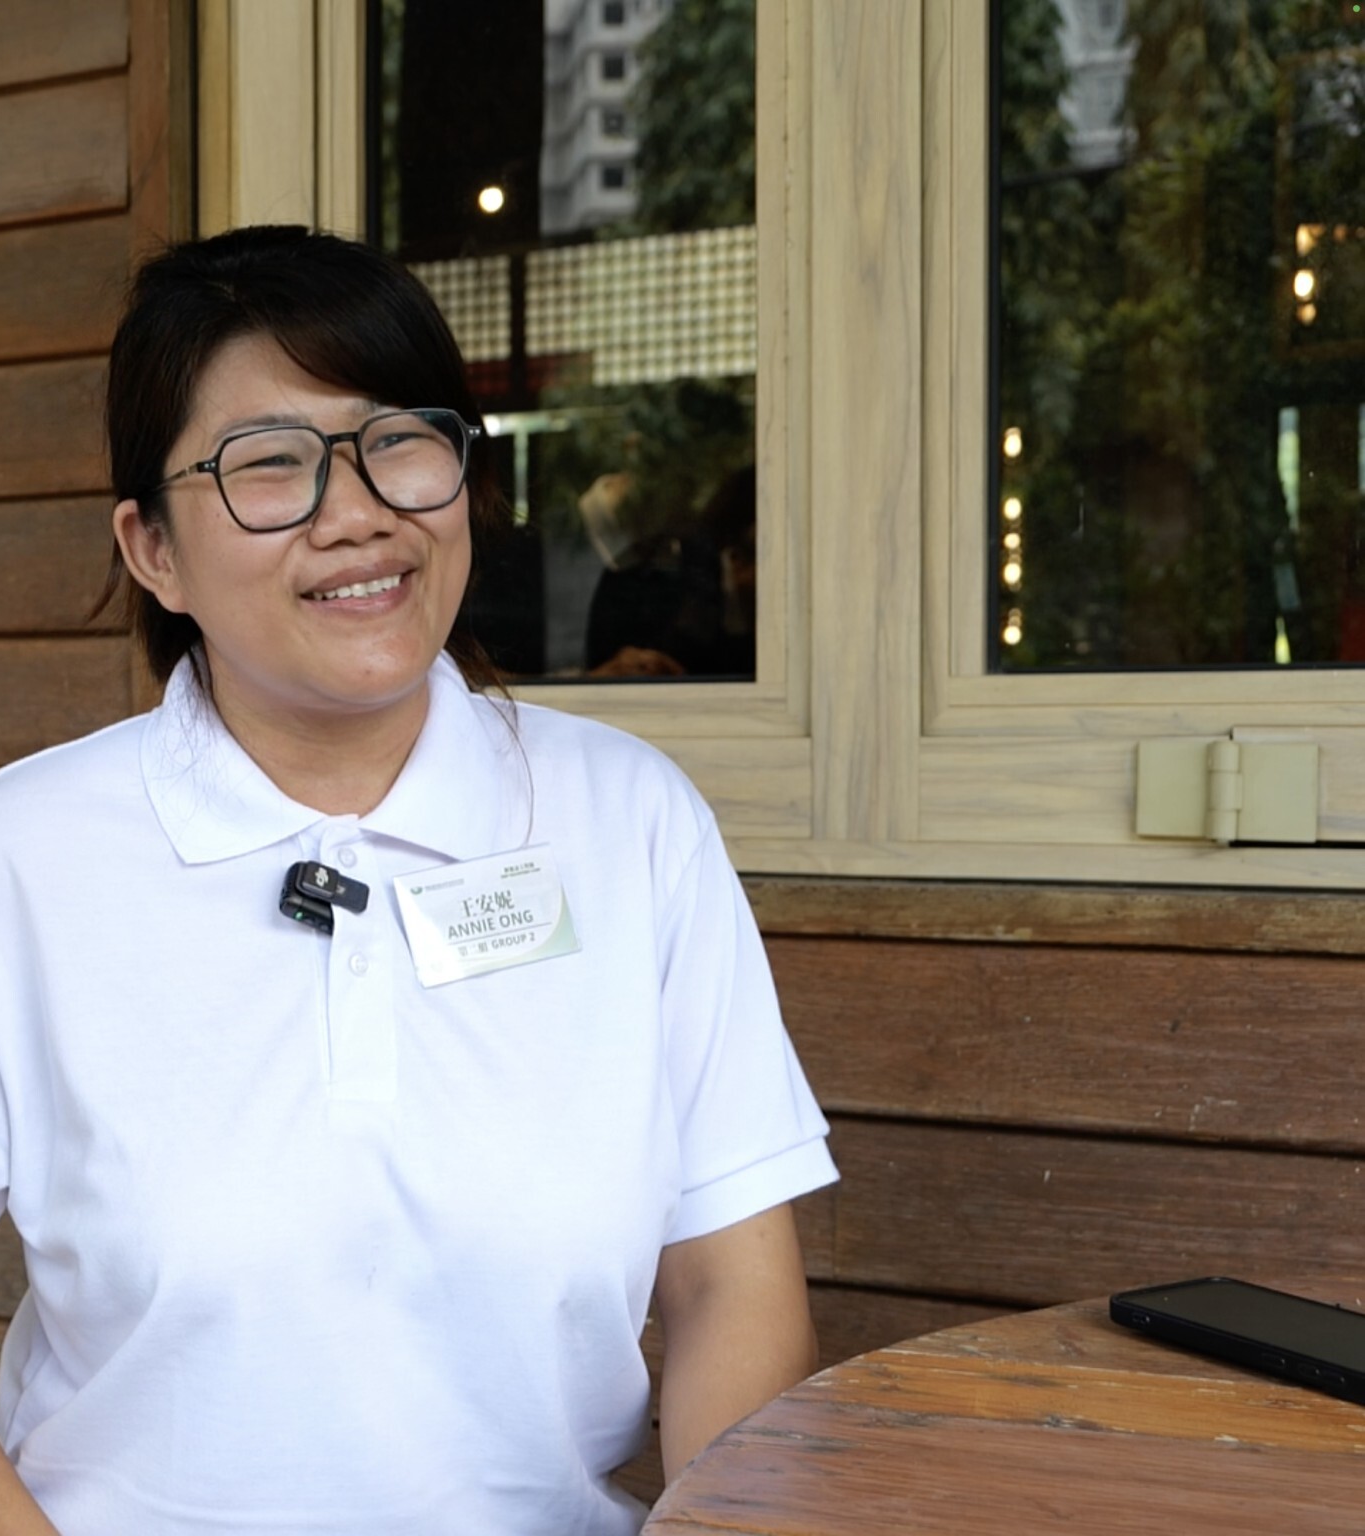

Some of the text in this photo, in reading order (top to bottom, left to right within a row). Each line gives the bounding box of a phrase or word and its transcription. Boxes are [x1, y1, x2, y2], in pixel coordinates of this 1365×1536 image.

[460, 889, 515, 918] 王安妮
[447, 909, 534, 940] ANNIE ONG
[491, 933, 527, 950] GROUP
[529, 932, 535, 942] 2
